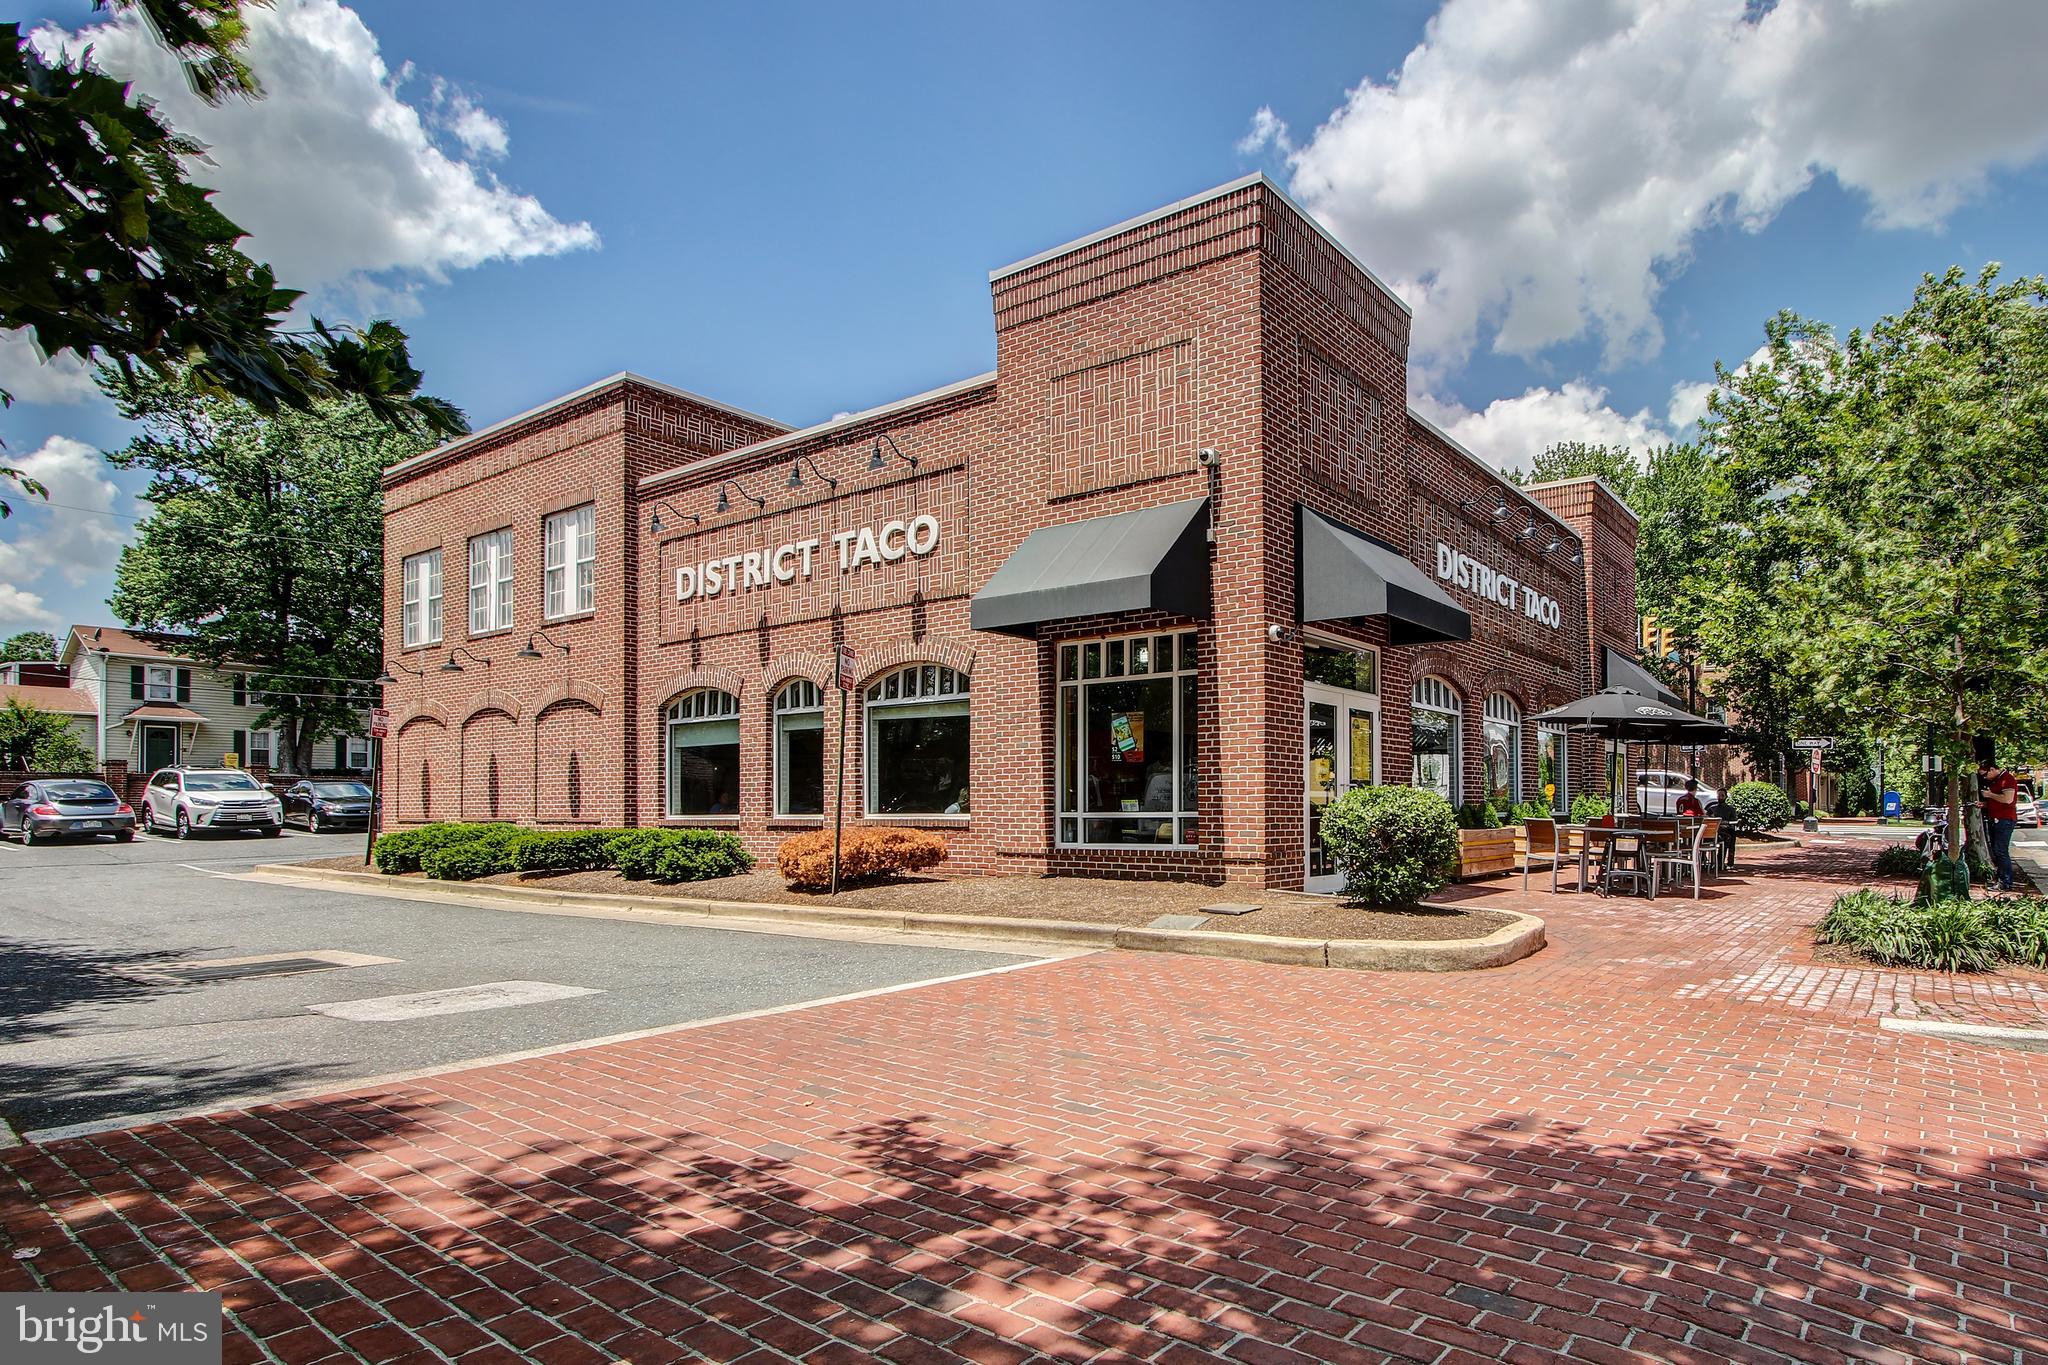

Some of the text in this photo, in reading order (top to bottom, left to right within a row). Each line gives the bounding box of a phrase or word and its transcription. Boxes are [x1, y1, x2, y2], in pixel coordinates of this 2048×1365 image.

[676, 514, 941, 602] DISTRICT TACO
[1437, 542, 1561, 630] DISTRICT TACO
